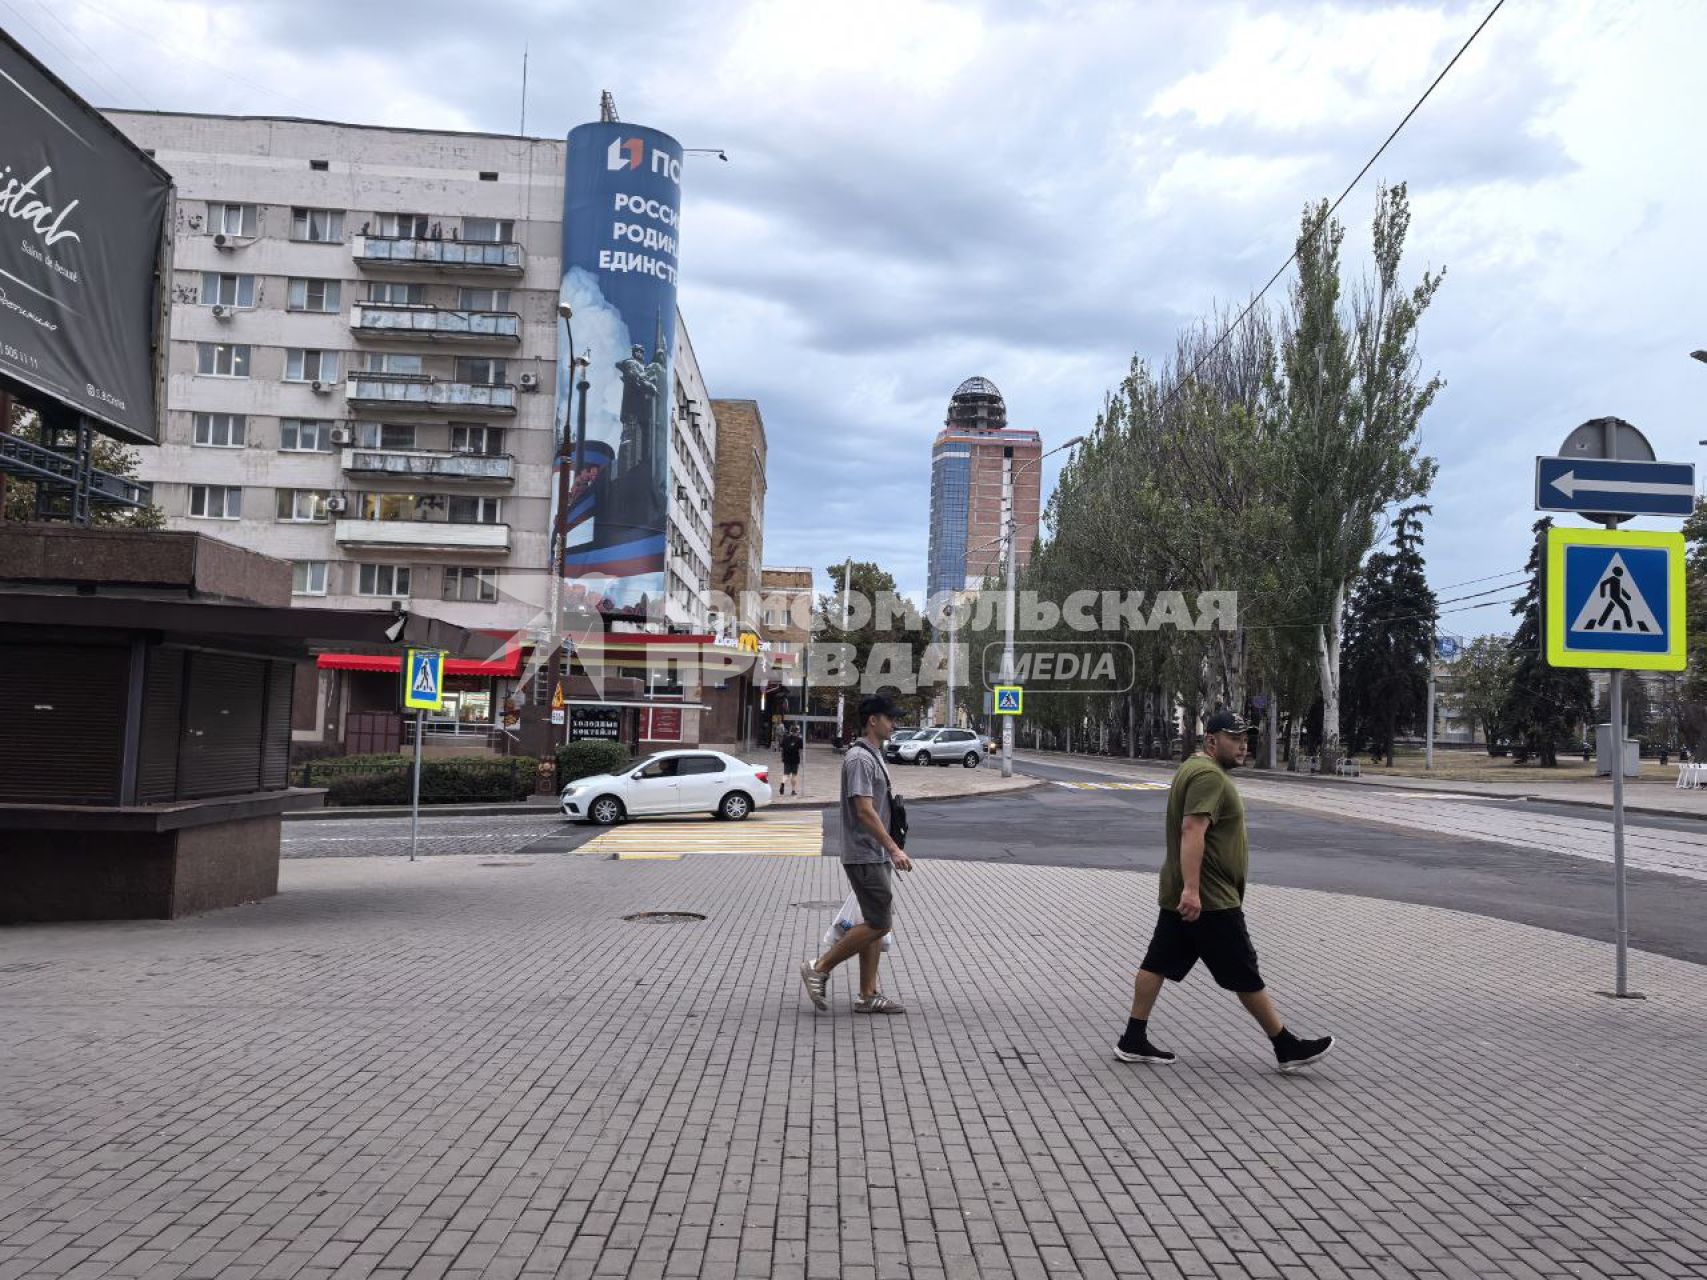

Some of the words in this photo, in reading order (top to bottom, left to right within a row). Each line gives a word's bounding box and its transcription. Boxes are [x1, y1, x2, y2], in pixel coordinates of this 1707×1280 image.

[0, 165, 81, 246] stal
[614, 192, 680, 231] РОССИ
[21, 239, 42, 262] Salon
[613, 222, 679, 259] РОДИН
[572, 728, 618, 736] КОКТЕЙЛИ
